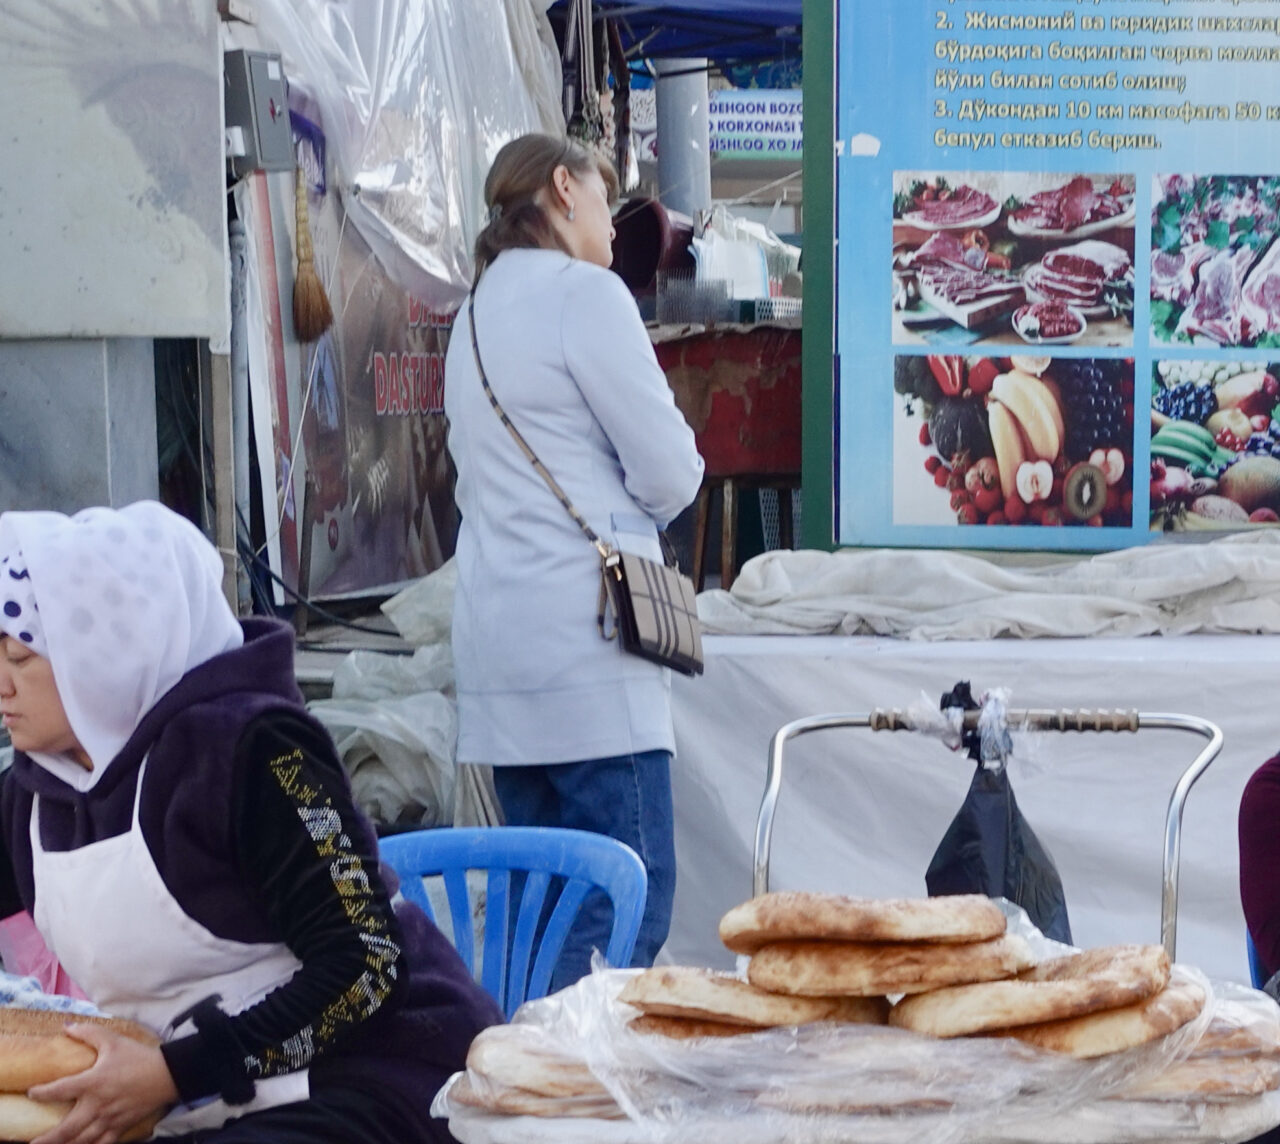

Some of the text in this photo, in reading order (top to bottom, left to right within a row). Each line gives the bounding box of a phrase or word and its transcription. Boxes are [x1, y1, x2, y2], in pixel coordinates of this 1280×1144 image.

[934, 11, 953, 30] 2.
[964, 11, 1075, 31] Жисмоний
[1081, 16, 1105, 31] ва
[1111, 16, 1192, 35] юридик
[1049, 41, 1146, 62] боқилган
[1151, 45, 1212, 64] чорва
[934, 69, 1186, 93] йўли билан сотиб олиш;
[709, 102, 766, 115] DEHQON
[934, 100, 952, 118] 3.
[958, 98, 1060, 121] Дўкондан
[1065, 101, 1091, 119] 10
[1096, 105, 1123, 119] км
[1128, 101, 1229, 124] масофага
[1235, 101, 1261, 121] 50
[717, 121, 795, 133] KORXONASI
[934, 128, 1162, 152] бепул етказиб бериш.
